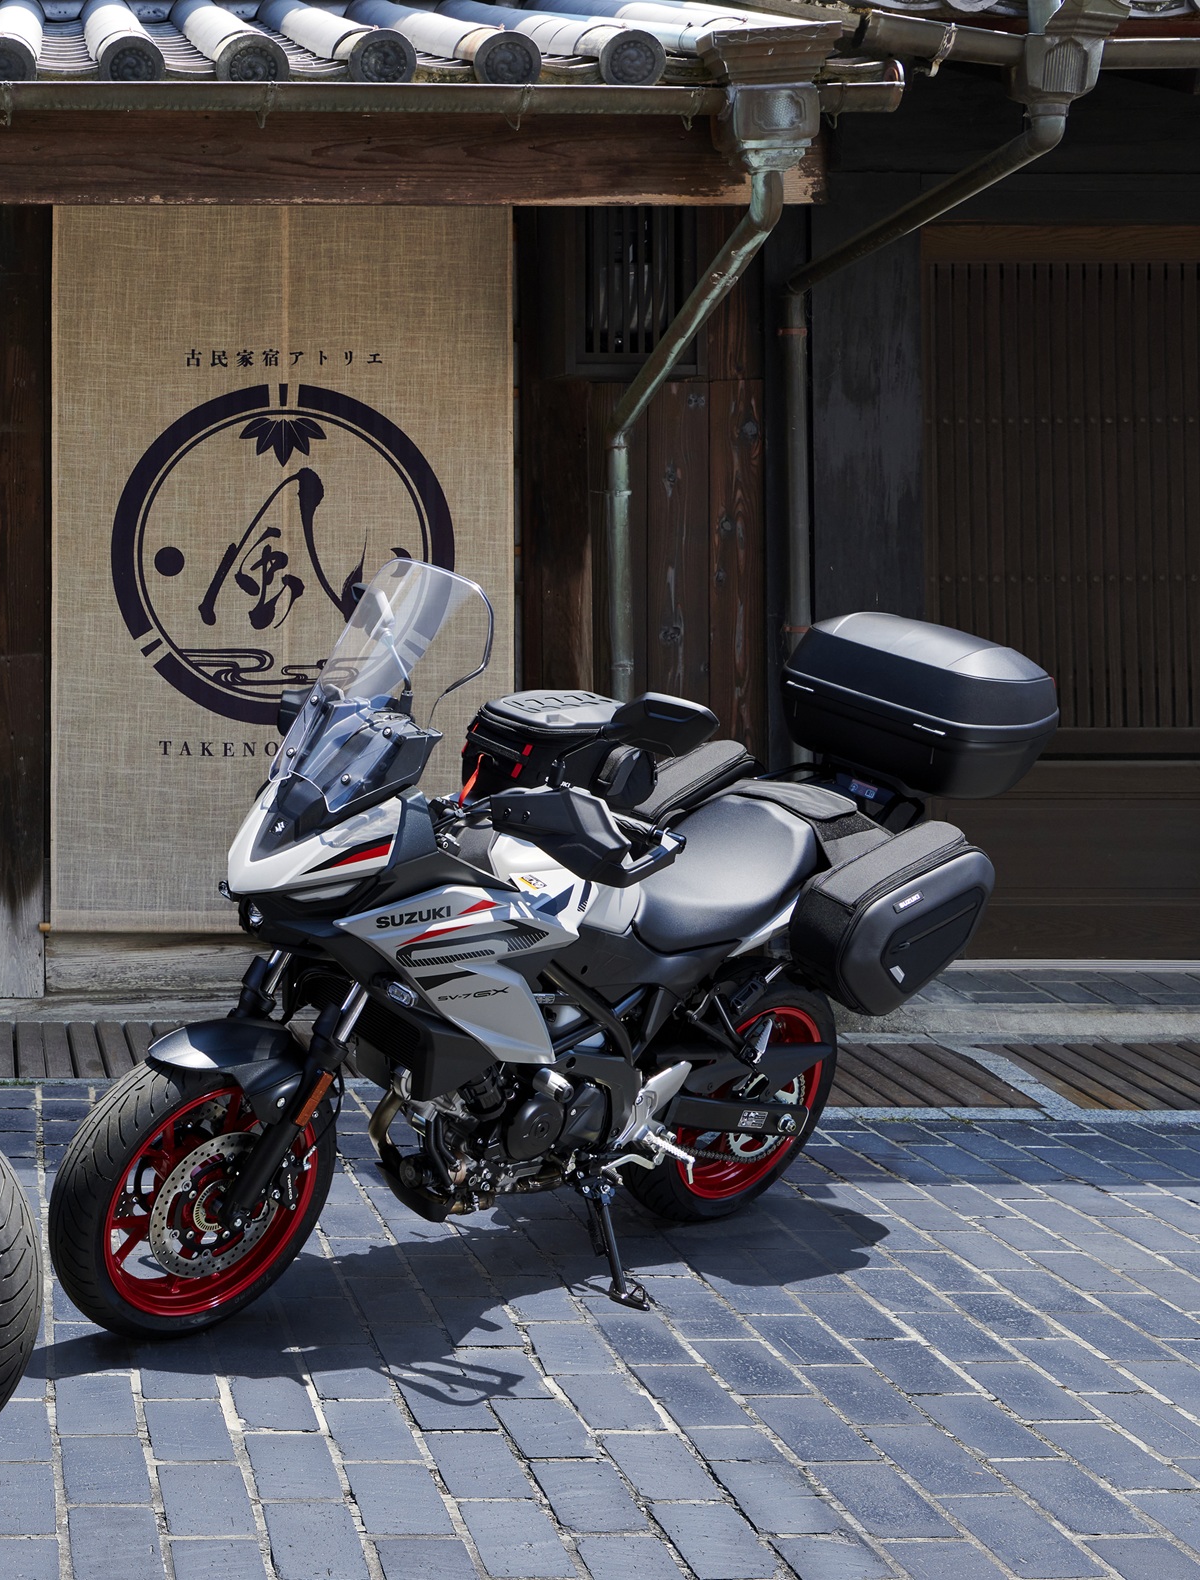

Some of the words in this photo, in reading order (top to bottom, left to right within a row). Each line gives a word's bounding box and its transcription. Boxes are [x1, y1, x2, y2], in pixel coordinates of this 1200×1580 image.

[184, 348, 383, 368] 古民家宿アトリエ
[376, 905, 452, 929] SUZUKI
